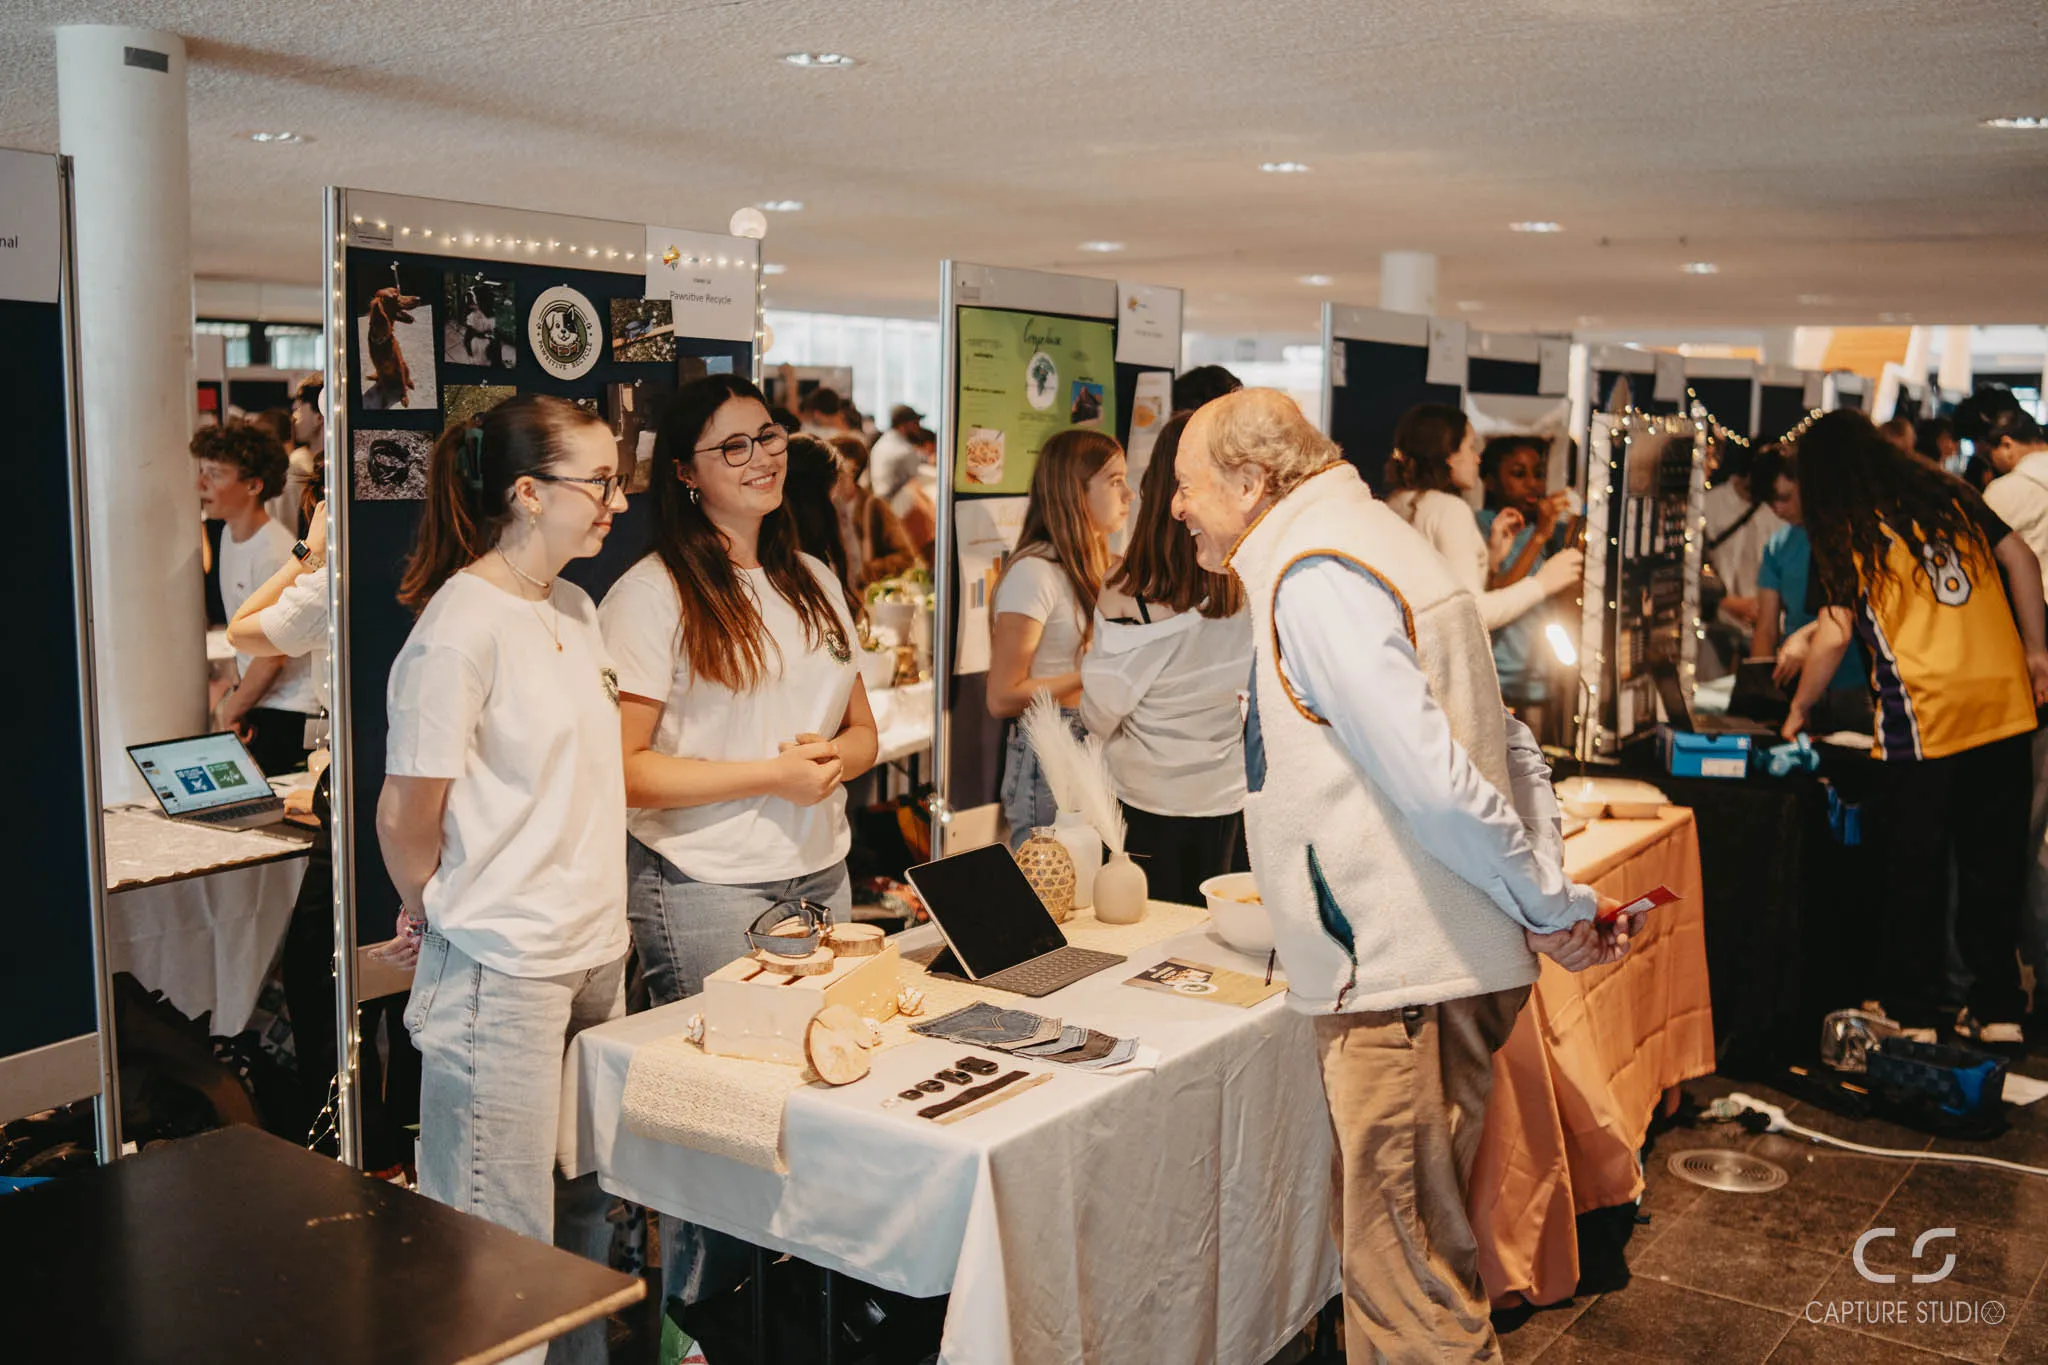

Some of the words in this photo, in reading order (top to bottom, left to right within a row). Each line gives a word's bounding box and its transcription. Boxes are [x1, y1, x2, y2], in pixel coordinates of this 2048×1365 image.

[670, 290, 704, 303] Pawsitive
[706, 294, 732, 305] Recycle
[538, 340, 567, 370] PAWSITIVE
[572, 342, 592, 369] RECYCLE
[1921, 540, 1972, 607] 8
